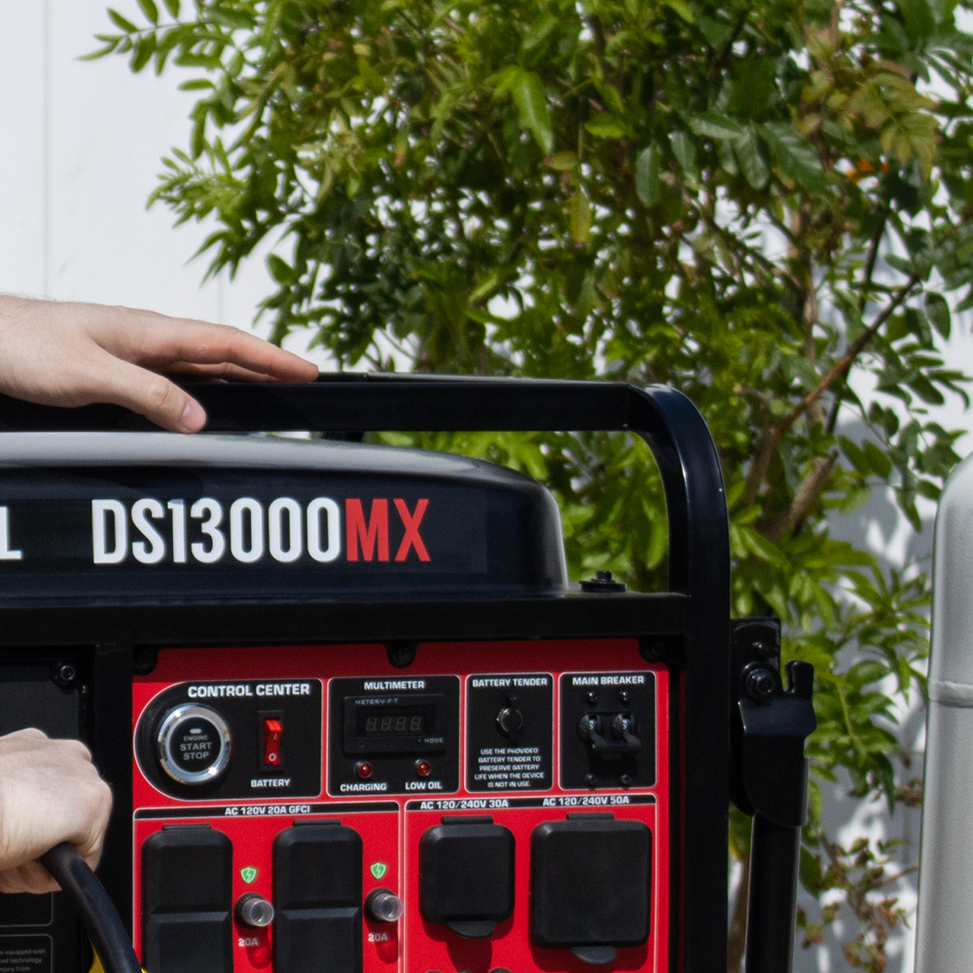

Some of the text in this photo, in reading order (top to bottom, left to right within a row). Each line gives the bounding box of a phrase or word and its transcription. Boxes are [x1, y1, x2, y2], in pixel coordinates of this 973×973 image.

[91, 497, 431, 564] DS13000MX
[364, 680, 425, 690] MULTIMETER
[472, 678, 548, 688] BATTERY TENDER
[572, 675, 644, 685] MAIN BREAKER
[188, 683, 311, 698] CONTROL CENTER
[180, 742, 212, 751] START
[183, 752, 209, 761] STOP
[512, 763, 539, 771] BATTERY
[251, 779, 290, 788] BATTERY
[340, 782, 387, 792] CHARGING
[405, 781, 442, 790] LOW OIL
[420, 799, 509, 810] AC 120/240V 30A
[542, 795, 630, 806] AC 120/240V 50A
[224, 804, 311, 816] AC 120V 20A GFCI
[238, 937, 258, 947] 20A
[368, 932, 388, 942] 20A
